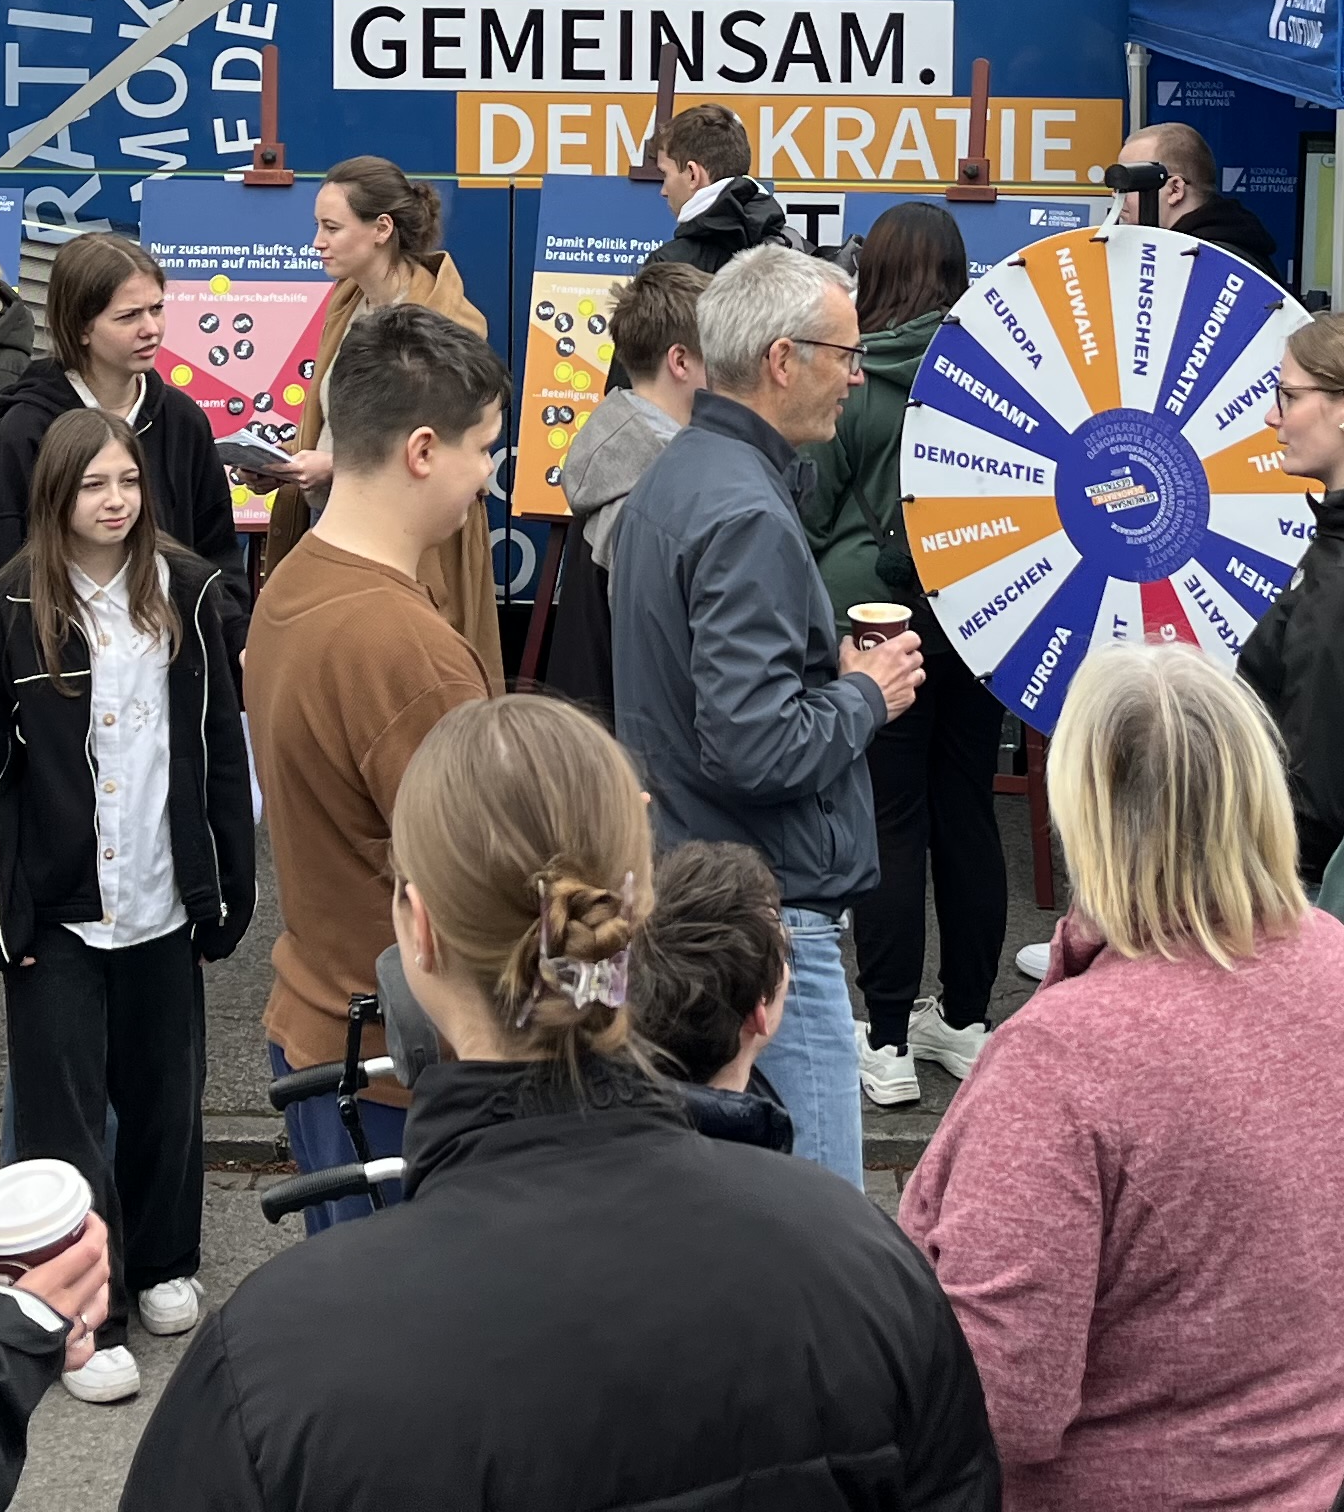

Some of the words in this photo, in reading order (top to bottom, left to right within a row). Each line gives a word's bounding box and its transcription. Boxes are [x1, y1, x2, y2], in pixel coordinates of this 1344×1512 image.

[349, 6, 937, 85] GEMEINSAM.
[1185, 98, 1230, 107] STIFTUNG
[478, 99, 1106, 181] DEMKRATIE.
[1250, 185, 1294, 193] STIFTUNG
[150, 243, 176, 254] Nur
[178, 245, 250, 256] zusammen
[187, 258, 216, 268] man
[221, 257, 245, 269] auf
[247, 258, 280, 269] mich
[545, 249, 594, 262] braucht
[597, 253, 611, 263] es
[613, 253, 634, 264] vor
[546, 236, 585, 249] Damit
[587, 237, 627, 250] Politik
[178, 293, 195, 302] der
[1056, 247, 1100, 365] NEUWAHL
[1132, 243, 1156, 376] MENSCHEN
[983, 287, 1043, 370] EUROPA
[1164, 272, 1245, 416] DEMOKRATIE
[933, 354, 1040, 434] EHRENAMT
[914, 443, 1045, 484] DEMOKRATIE
[920, 515, 1020, 553] NEUWAHL
[958, 557, 1053, 640] MENSCHEN
[1020, 626, 1073, 710] EUROPA
